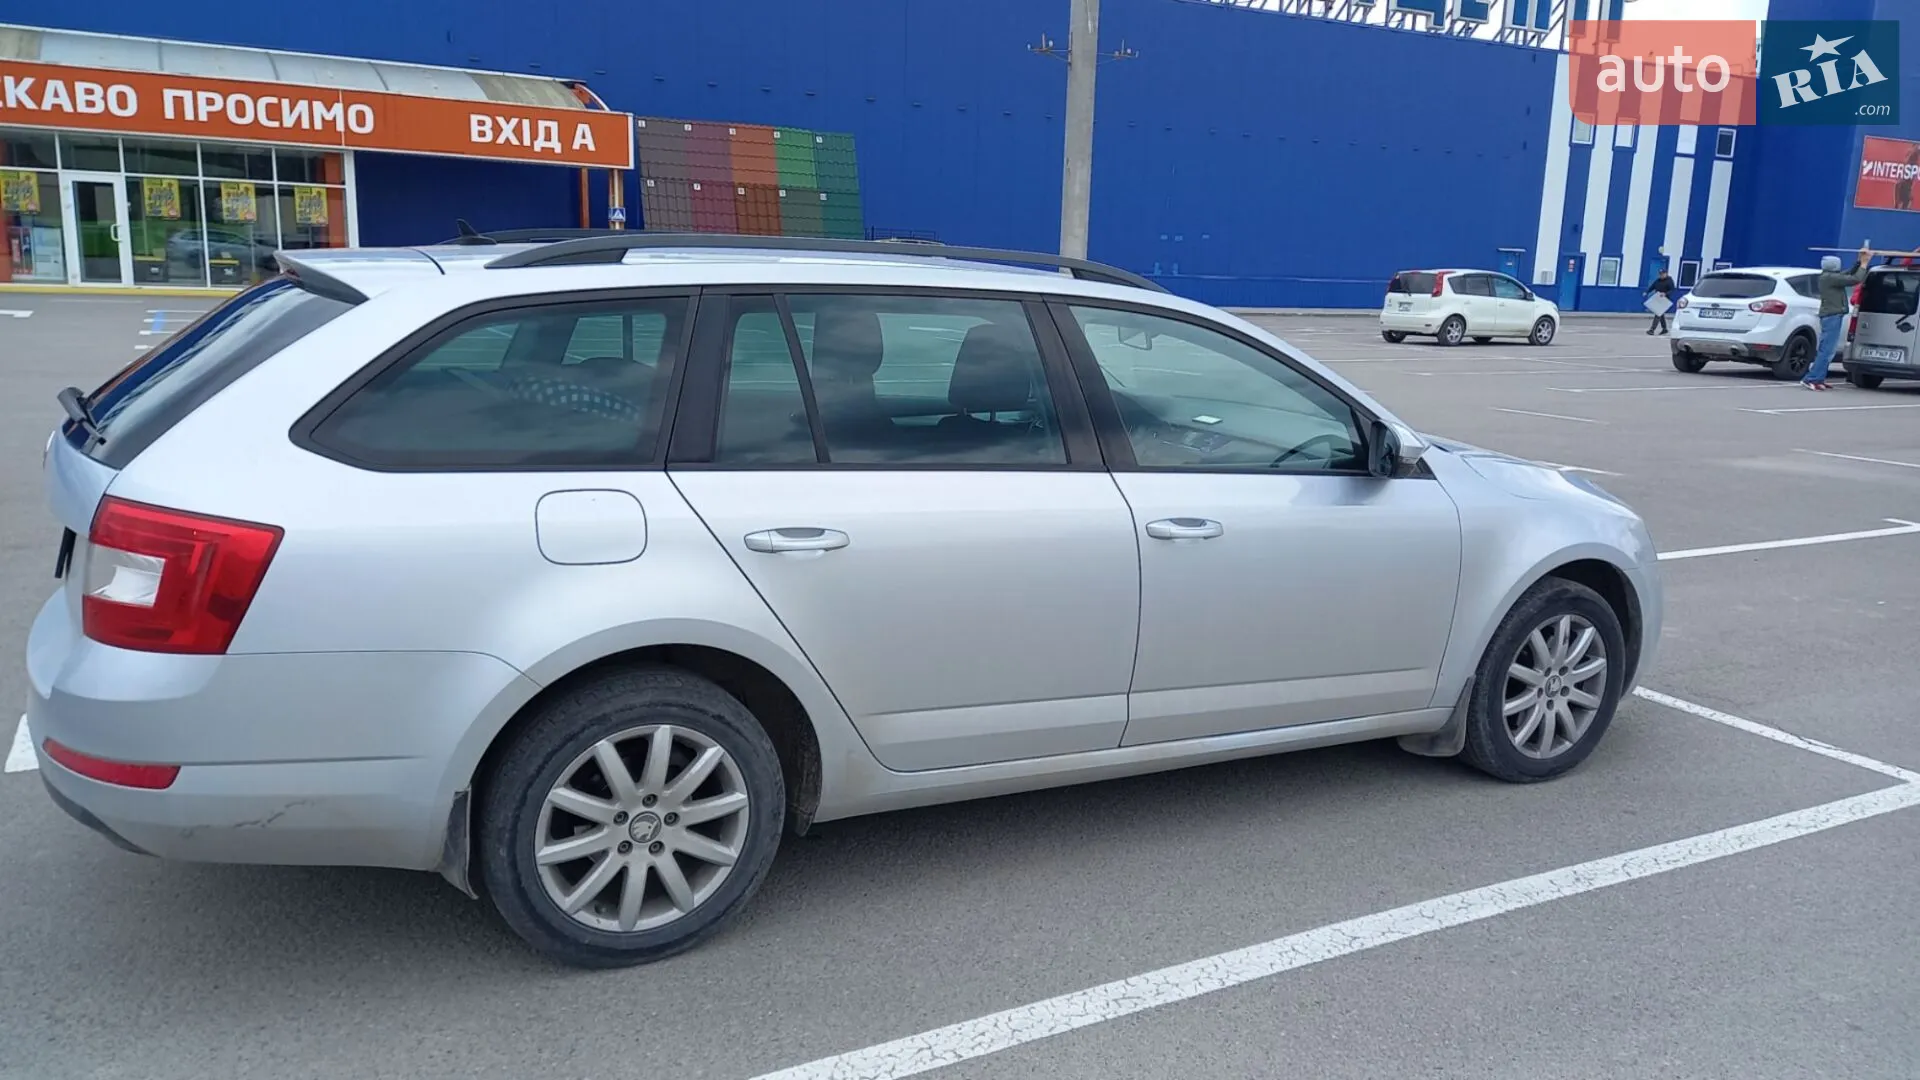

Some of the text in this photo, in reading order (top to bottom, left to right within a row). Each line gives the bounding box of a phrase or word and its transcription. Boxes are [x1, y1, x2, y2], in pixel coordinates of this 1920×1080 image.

[0, 75, 375, 135] КАВО ПРОСИМО
[469, 114, 563, 153] ВХІД
[1872, 160, 1920, 181] INTERSP
